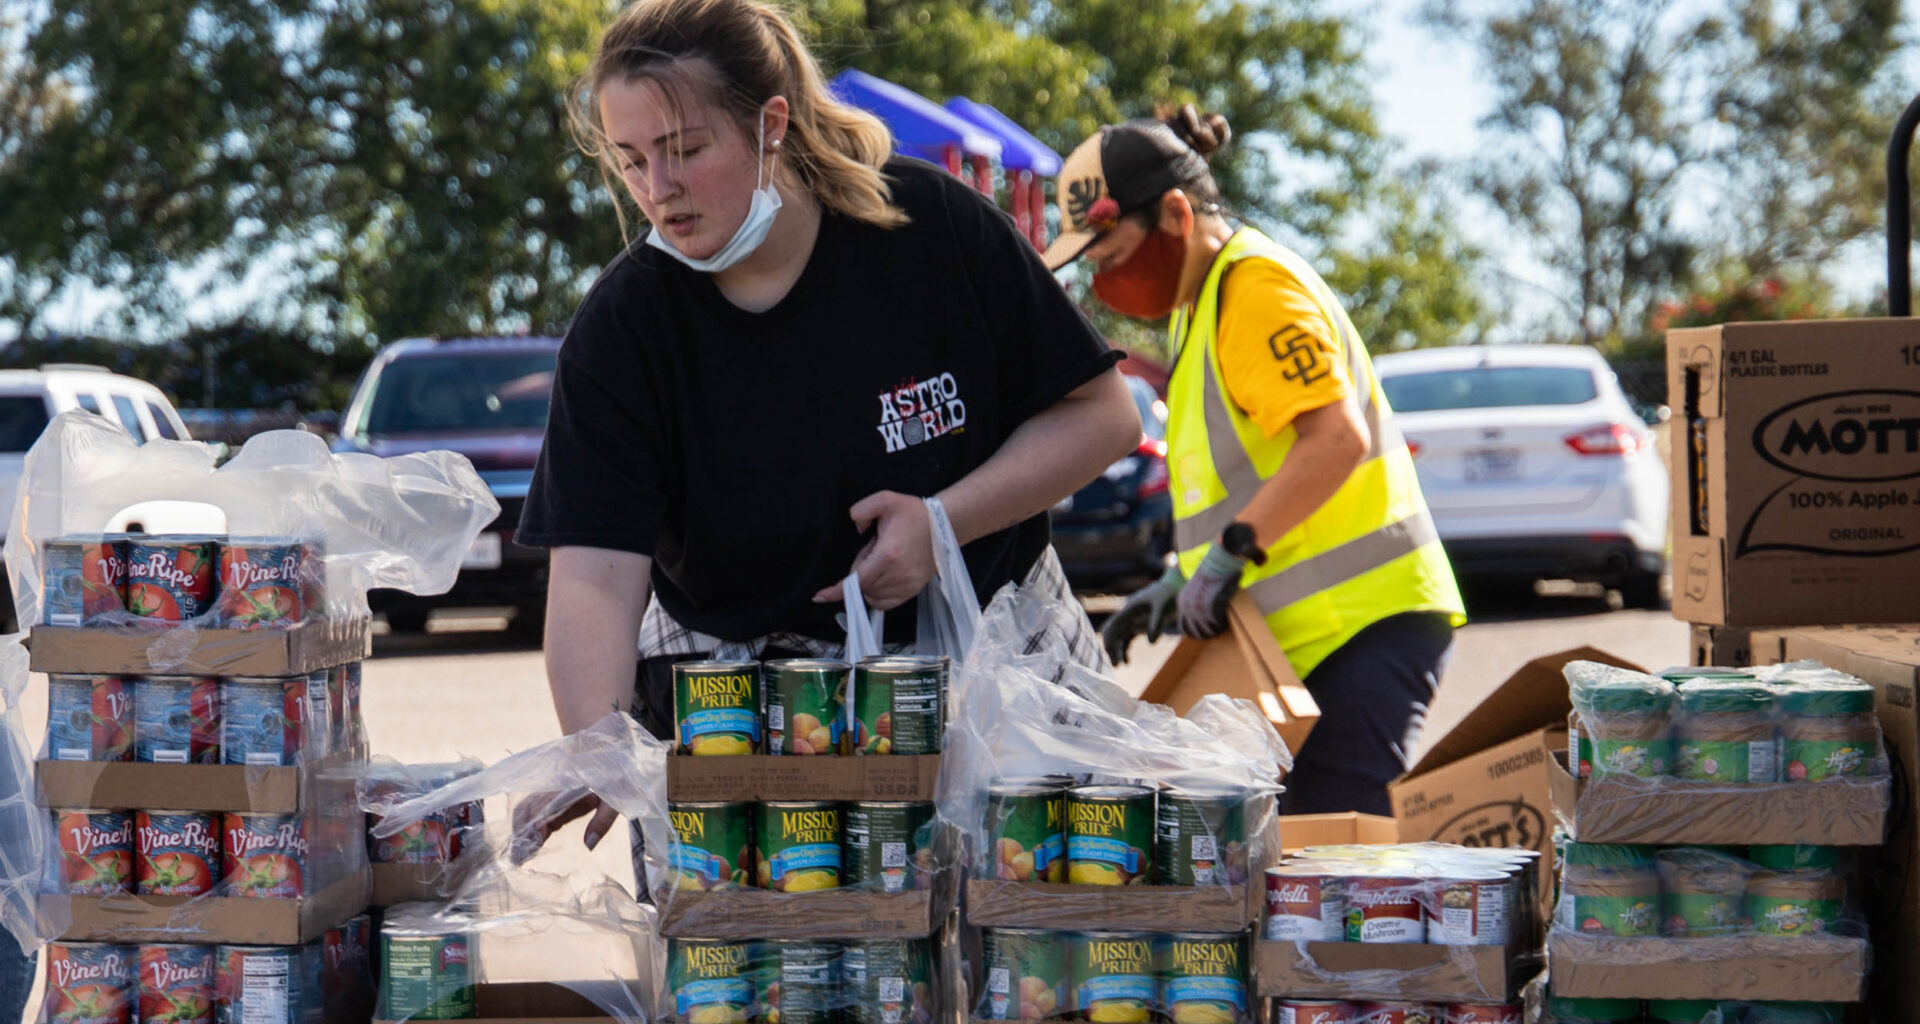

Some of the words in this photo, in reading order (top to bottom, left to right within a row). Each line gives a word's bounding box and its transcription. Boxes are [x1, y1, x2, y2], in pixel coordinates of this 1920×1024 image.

[1751, 350, 1776, 363] GAL
[1730, 365, 1777, 378] PLASTIC
[1779, 363, 1829, 376] BOTTLES
[878, 371, 958, 424] ASTRO
[876, 398, 966, 453] WORLD
[1789, 491, 1844, 508] 100%
[1848, 488, 1908, 509] Apple
[1829, 527, 1905, 541] ORIGINAL
[149, 552, 195, 588] Ripe
[231, 560, 280, 590] Vine
[688, 674, 752, 704] MISSION
[701, 694, 743, 708] PRIDE
[873, 784, 919, 796] USDA
[70, 826, 121, 856] Vine
[138, 825, 182, 854] Vine
[229, 827, 276, 857] Vine
[796, 828, 834, 843] PRIDE
[1074, 821, 1112, 836] PRIDE
[1363, 928, 1406, 941] Mushroom
[686, 944, 749, 975] MISSION
[1088, 941, 1153, 969] MISSION
[1101, 960, 1144, 974] PRIDE
[1172, 942, 1239, 969] MISSION
[1183, 961, 1227, 975] PRIDE
[54, 959, 100, 987] Vine
[101, 952, 129, 984] Rip
[150, 961, 200, 989] Vine
[700, 963, 740, 978] PRIDE
